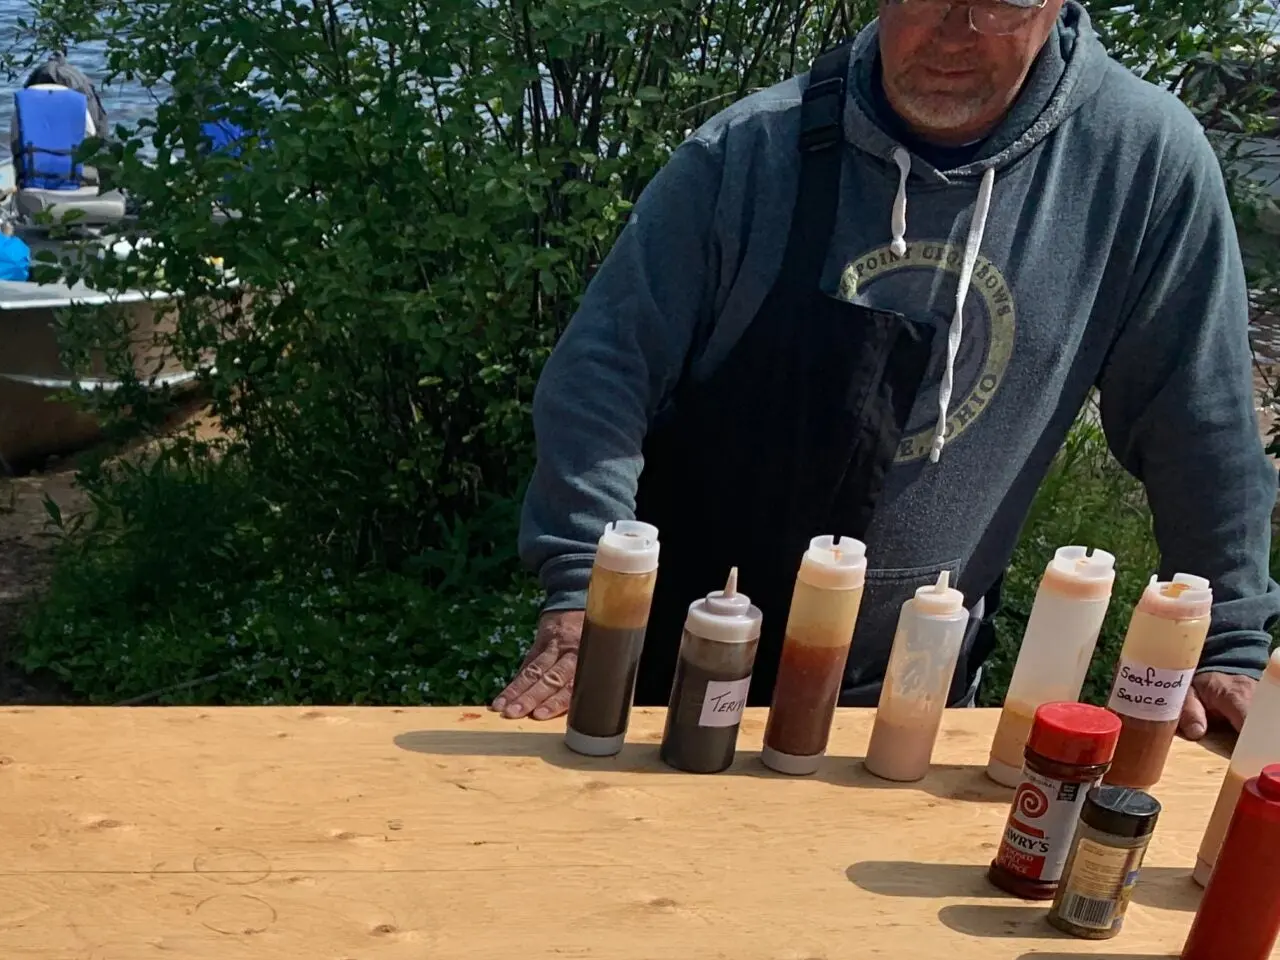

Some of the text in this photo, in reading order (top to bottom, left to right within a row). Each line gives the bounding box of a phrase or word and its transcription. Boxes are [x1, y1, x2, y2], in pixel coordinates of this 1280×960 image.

[922, 246, 1011, 317] CROBOWS
[1120, 666, 1184, 689] Seafood
[1117, 687, 1168, 706] Sauce
